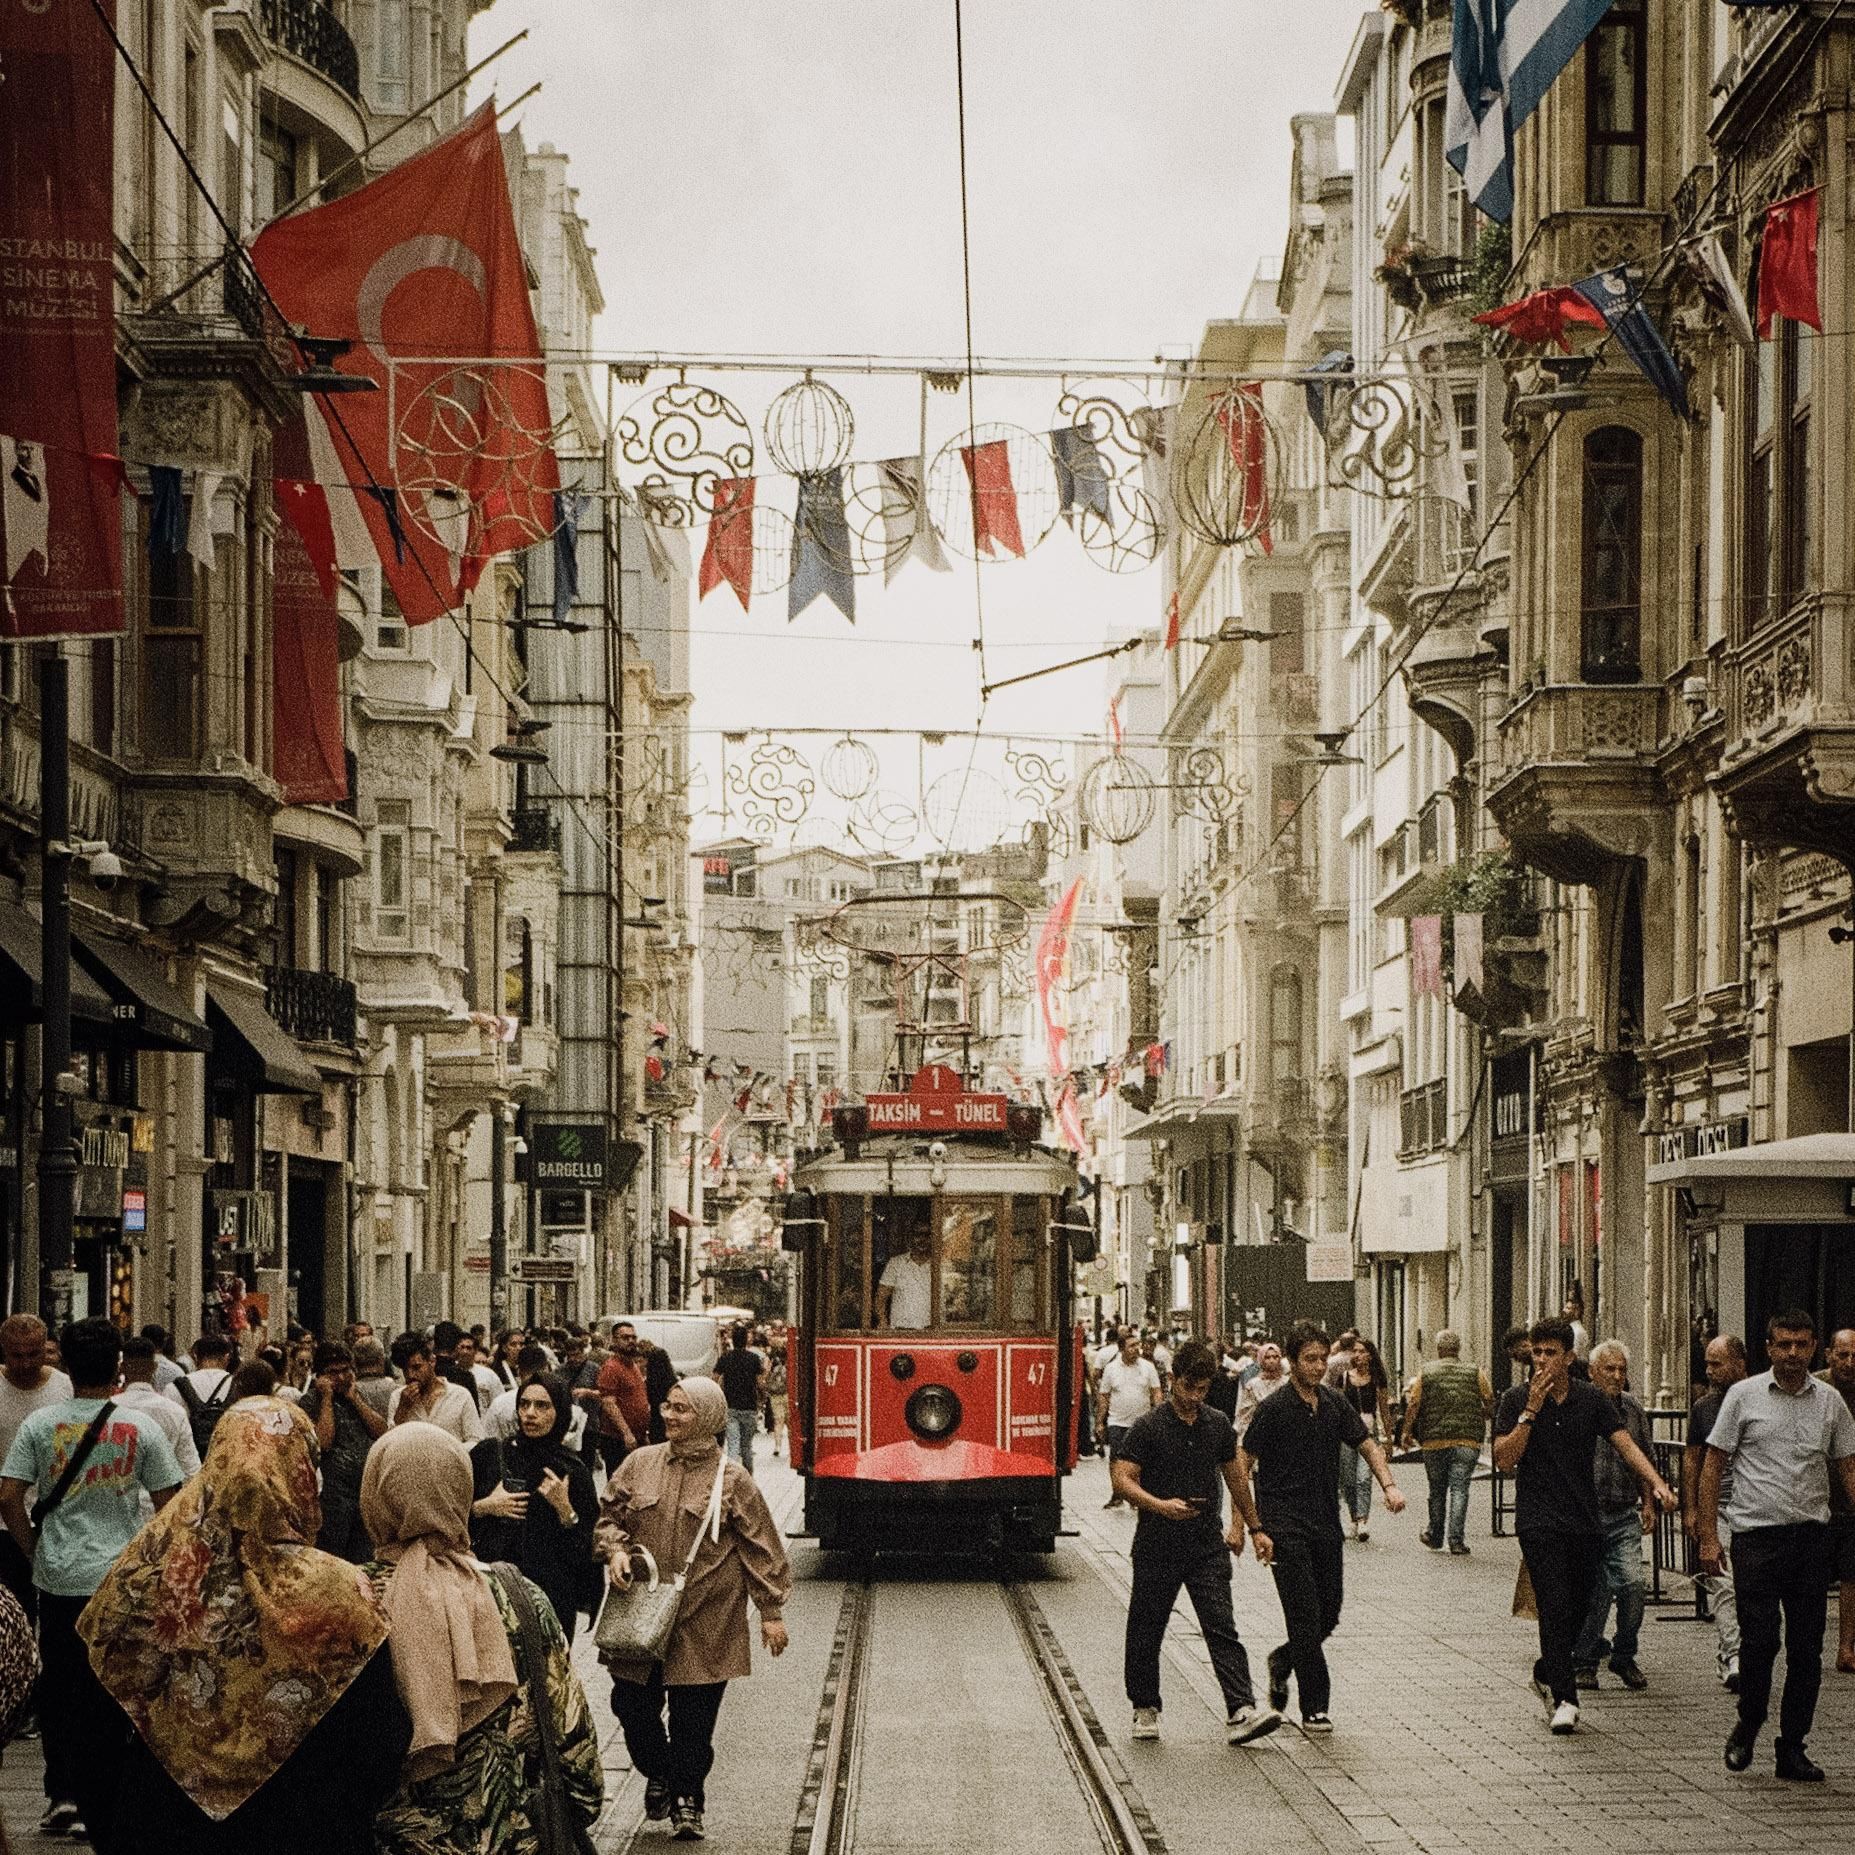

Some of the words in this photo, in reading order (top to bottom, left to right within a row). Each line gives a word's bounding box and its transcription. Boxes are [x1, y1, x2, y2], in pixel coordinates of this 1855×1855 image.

[3, 263, 101, 290] SİNEMA
[931, 1066, 941, 1090] 1
[868, 1099, 922, 1122] TAKSİM
[954, 1099, 1002, 1122] TÜNEL
[537, 1161, 603, 1178] BARGELLO
[824, 1364, 839, 1388] 47
[1027, 1362, 1046, 1386] 47
